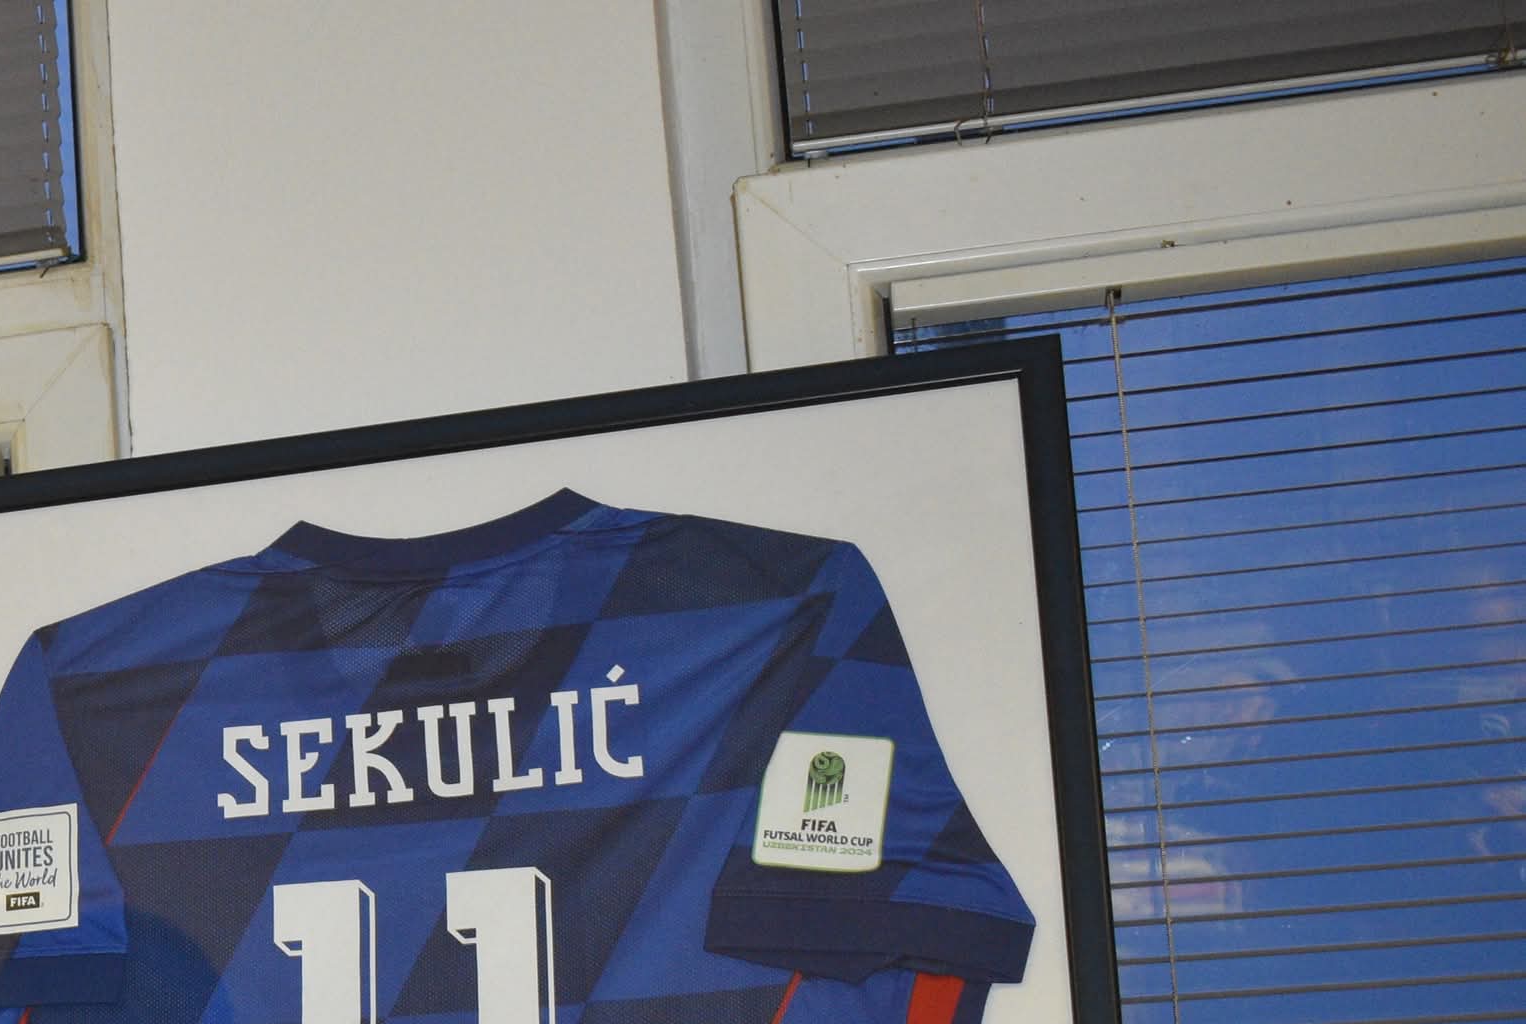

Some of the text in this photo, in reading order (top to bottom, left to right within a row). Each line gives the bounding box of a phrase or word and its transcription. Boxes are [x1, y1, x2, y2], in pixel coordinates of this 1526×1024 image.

[217, 664, 644, 819] SEKULIĆ
[801, 819, 837, 833] FIFA
[763, 829, 873, 848] FUTSAL WORLD CUP
[15, 867, 57, 889] World
[10, 896, 36, 908] FIFA
